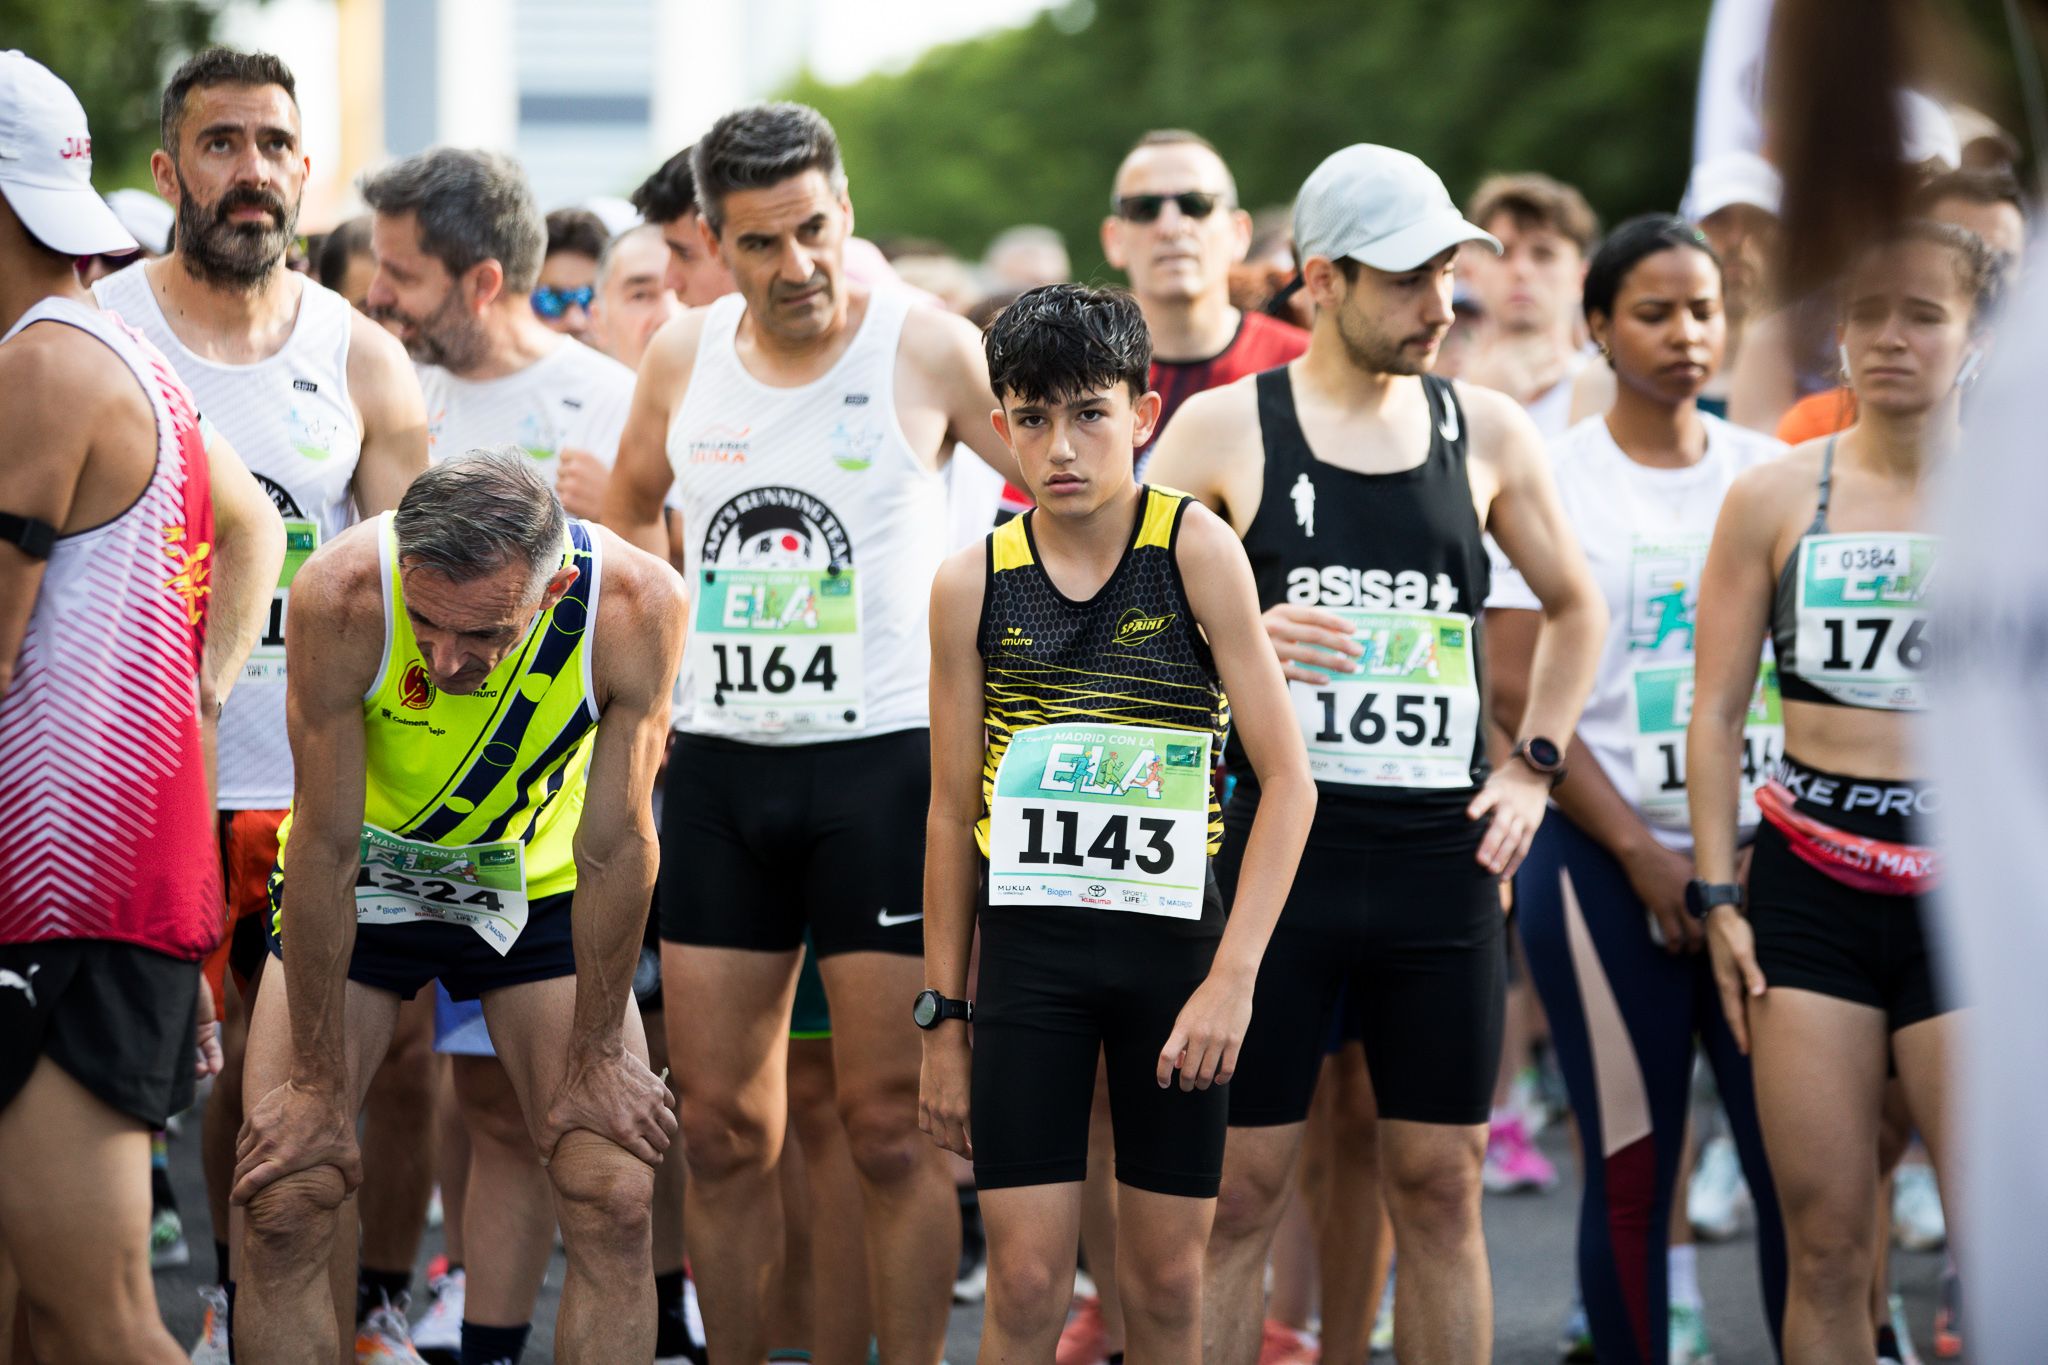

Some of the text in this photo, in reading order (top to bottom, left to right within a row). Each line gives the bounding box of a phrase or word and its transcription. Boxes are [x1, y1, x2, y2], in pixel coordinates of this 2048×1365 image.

[1841, 548, 1896, 569] 0384
[722, 584, 818, 629] ELA
[713, 644, 837, 694] 1164
[393, 716, 429, 726] Colmena
[1316, 692, 1451, 746] 1651
[1054, 732, 1106, 744] MADRID
[1109, 734, 1136, 746] CON
[1139, 737, 1155, 747] LA
[1038, 743, 1163, 800] ELA
[1843, 784, 1943, 817] PRO
[370, 836, 419, 854] MADRID
[422, 848, 449, 858] CON
[1019, 808, 1176, 875] 1143
[1047, 887, 1073, 898] Biogen
[1122, 889, 1144, 897] SPORT
[1124, 896, 1140, 904] LIFE
[382, 905, 407, 916] Biogen
[1166, 899, 1193, 909] MADRID
